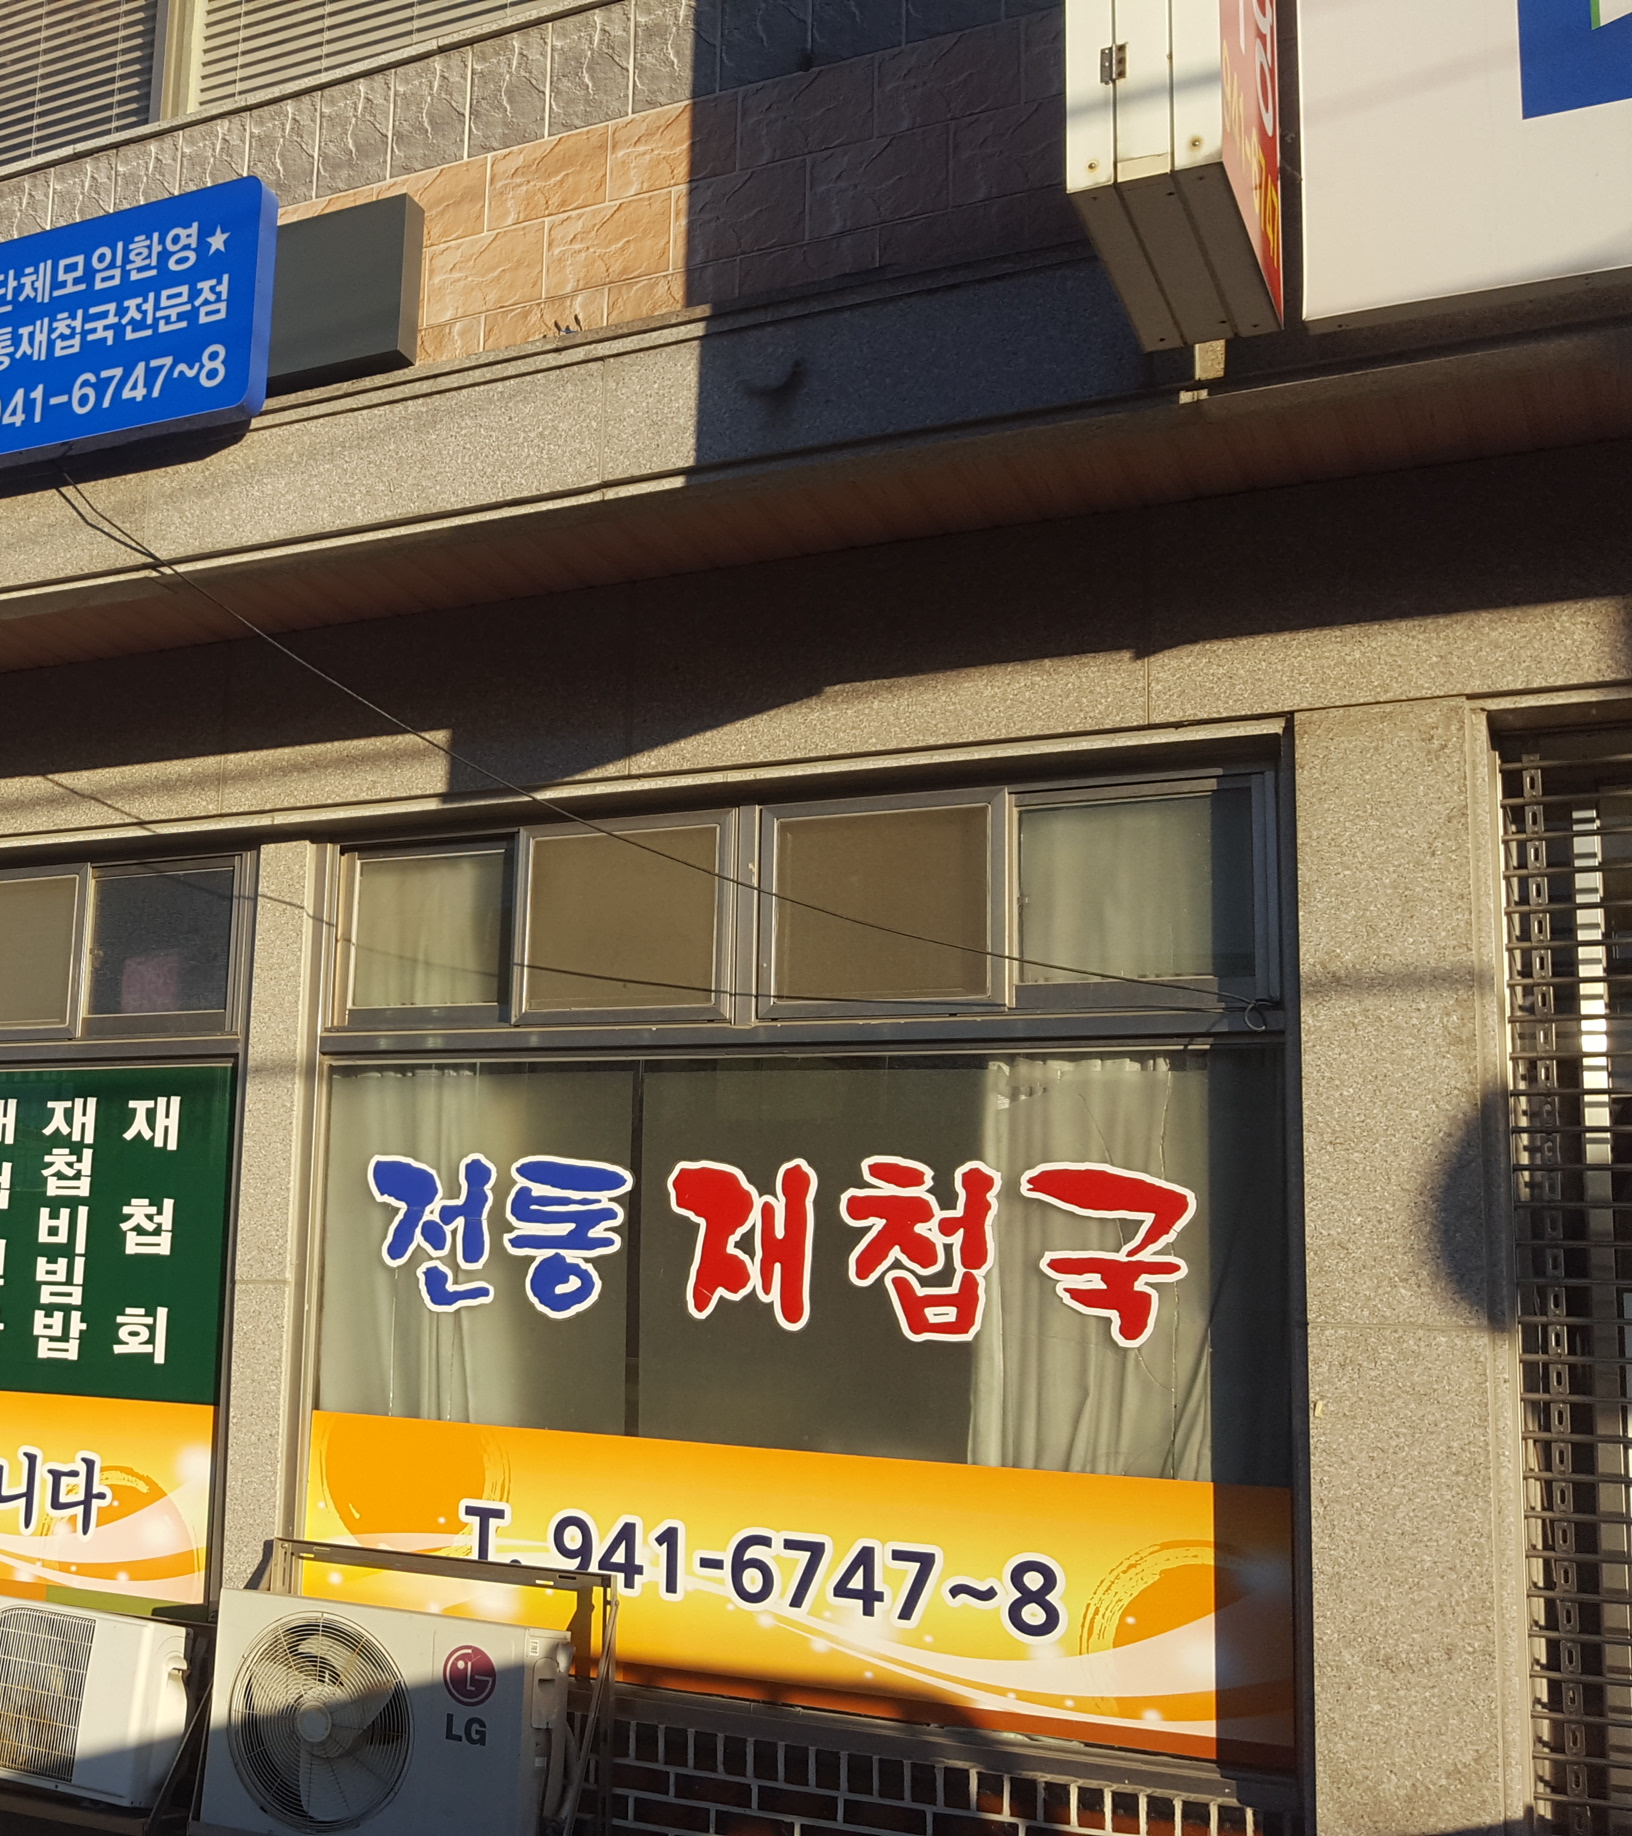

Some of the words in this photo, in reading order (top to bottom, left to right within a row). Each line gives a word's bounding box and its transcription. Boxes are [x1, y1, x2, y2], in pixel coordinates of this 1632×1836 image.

[33, 1097, 97, 1360] 재첩비빔밥
[113, 1096, 181, 1364] 재첩회
[369, 1154, 633, 1319] 전통
[668, 1155, 1197, 1348] 재첩국
[552, 1514, 1062, 1638] 941-6747~8
[445, 1712, 487, 1747] LG
